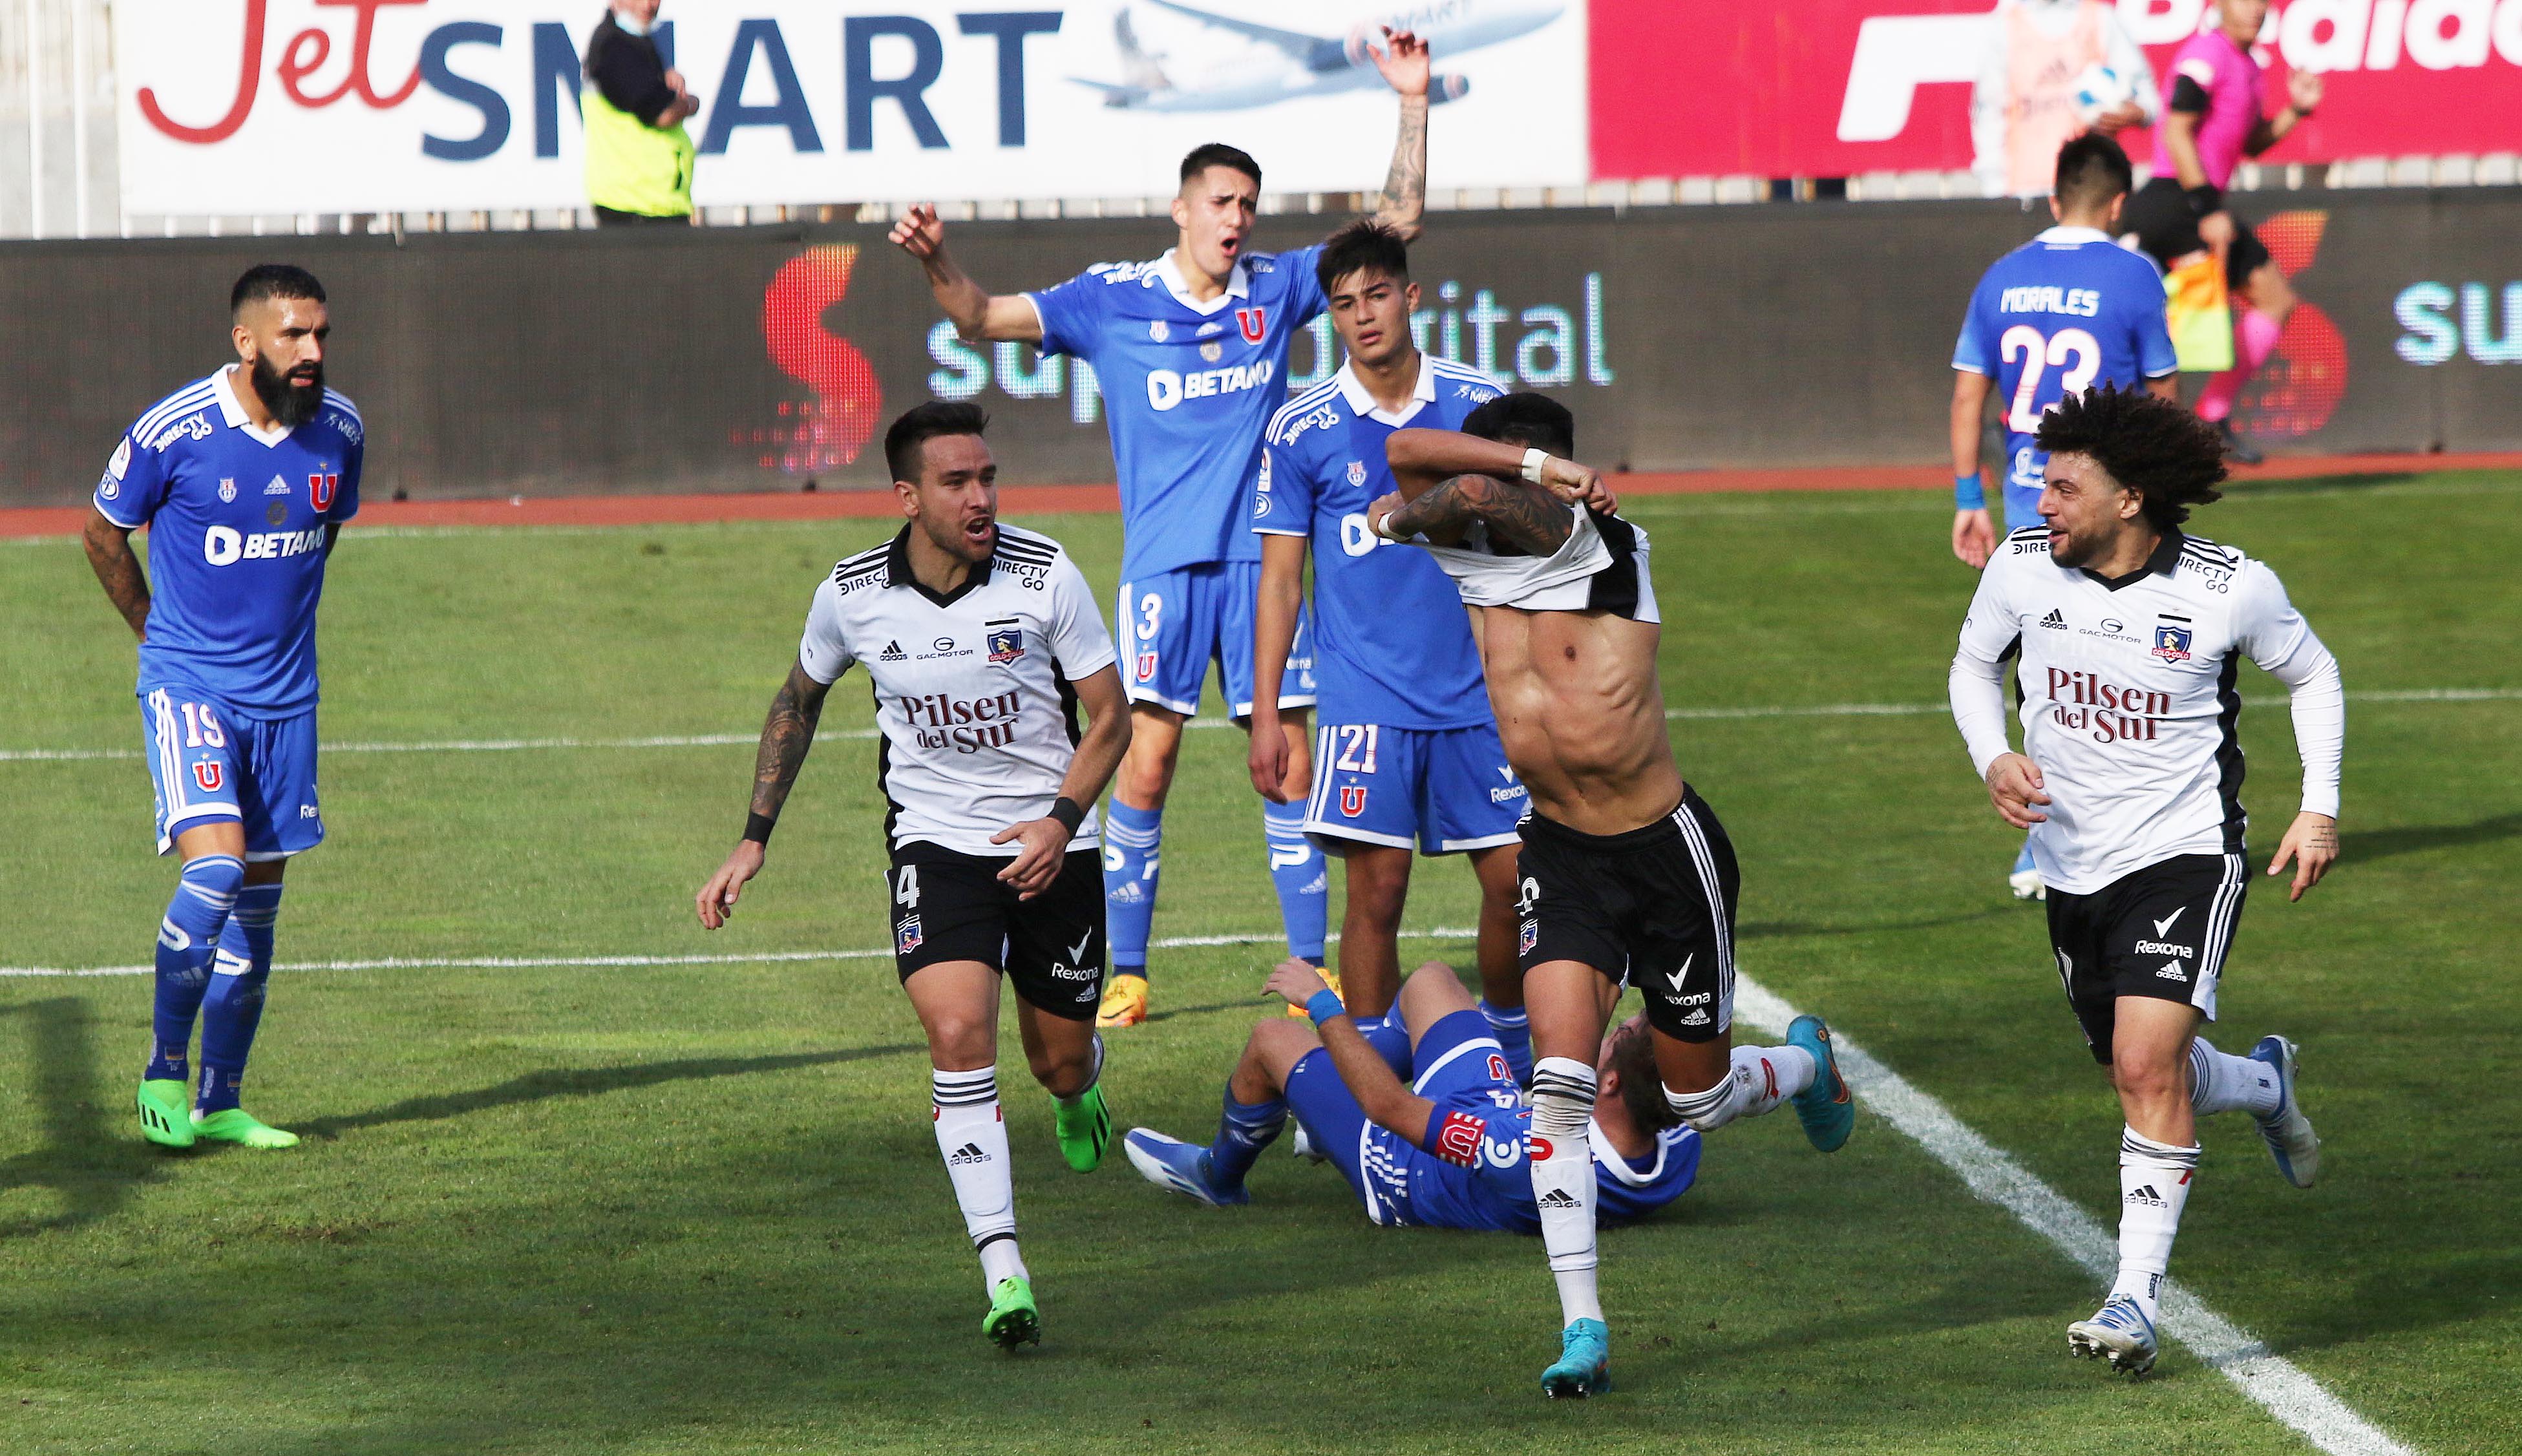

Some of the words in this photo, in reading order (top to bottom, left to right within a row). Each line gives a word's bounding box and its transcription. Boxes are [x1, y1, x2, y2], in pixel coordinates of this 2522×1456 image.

[2000, 286, 2100, 317] MORALES
[1235, 308, 1266, 345] U
[2000, 324, 2101, 435] 23
[151, 411, 204, 454] DIRECTV
[191, 423, 213, 441] GO
[1281, 402, 1331, 447] DIRECTV
[1318, 413, 1340, 430] GO
[308, 472, 338, 513] U
[838, 567, 885, 596] DIRECT
[1023, 578, 1044, 591] GO
[2179, 556, 2233, 582] IRECTV
[2205, 580, 2229, 594] GO
[1136, 593, 1162, 640] 3
[2039, 620, 2068, 630] adidas
[880, 653, 907, 661] adidas
[1137, 651, 1159, 683] U
[2152, 648, 2189, 659] COLO-COLO
[2047, 666, 2171, 715] Pilsen
[901, 690, 1021, 728] Pilsen
[2053, 706, 2088, 730] del
[2093, 710, 2163, 743] Sur
[180, 701, 226, 749] 19
[917, 729, 948, 750] del
[952, 717, 1019, 754] Sur
[1335, 724, 1379, 774] 21
[191, 761, 224, 793] U
[1339, 786, 1367, 818] U
[1490, 785, 1529, 803] Rexo
[896, 864, 920, 909] 4
[2134, 940, 2193, 959] Rexona
[1052, 962, 1098, 981] Rexona
[2156, 970, 2187, 982] adidas
[949, 1154, 991, 1166] adidas
[1538, 1199, 1582, 1208] adidas
[2124, 1196, 2167, 1208] adidas
